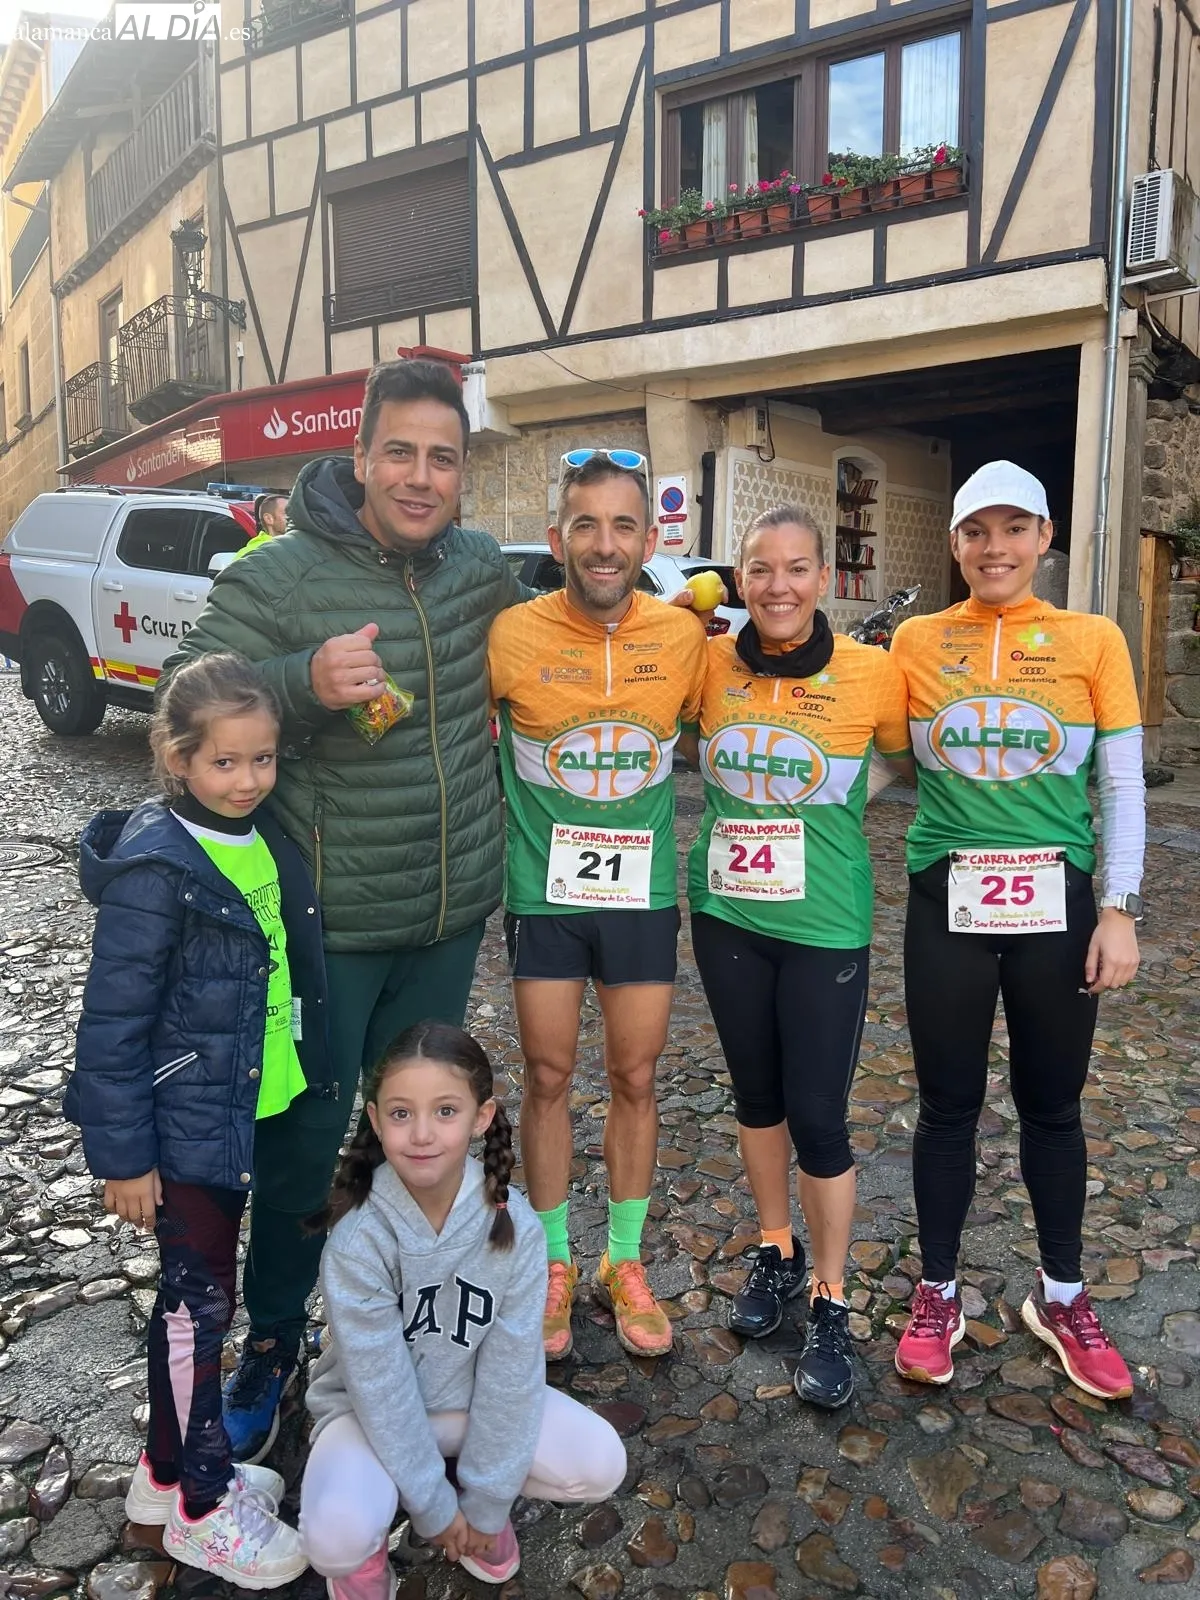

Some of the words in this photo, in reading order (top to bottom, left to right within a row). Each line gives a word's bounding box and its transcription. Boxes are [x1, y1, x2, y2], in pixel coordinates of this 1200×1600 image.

[291, 405, 363, 436] Santan
[137, 443, 182, 478] Santander
[141, 615, 178, 639] Cruz
[624, 674, 668, 684] Helmántica
[1008, 677, 1057, 685] Helmántica
[973, 684, 1065, 716] DEPORTIVO
[544, 716, 581, 738] CLUB
[588, 708, 666, 737] DEPORTIVO
[785, 710, 832, 723] Helmántica
[708, 712, 740, 734] CLUB
[747, 712, 832, 749] DEPORTIVO
[939, 726, 1051, 755] ALCER
[557, 750, 652, 773] ALCER
[713, 748, 814, 785] ALCER
[571, 831, 613, 844] CARRERA
[613, 834, 651, 845] POPULAR
[721, 824, 756, 835] CARRERA
[757, 824, 801, 835] POPULAR
[576, 851, 622, 882] 21
[728, 843, 776, 874] 24
[970, 854, 1017, 865] CARRERA
[1018, 852, 1059, 865] POPULA
[625, 895, 647, 903] Sierra
[769, 887, 779, 895] La
[779, 887, 801, 895] Sierra
[980, 875, 1035, 906] 25
[1039, 918, 1063, 926] Sierra
[402, 1272, 495, 1350] AP
